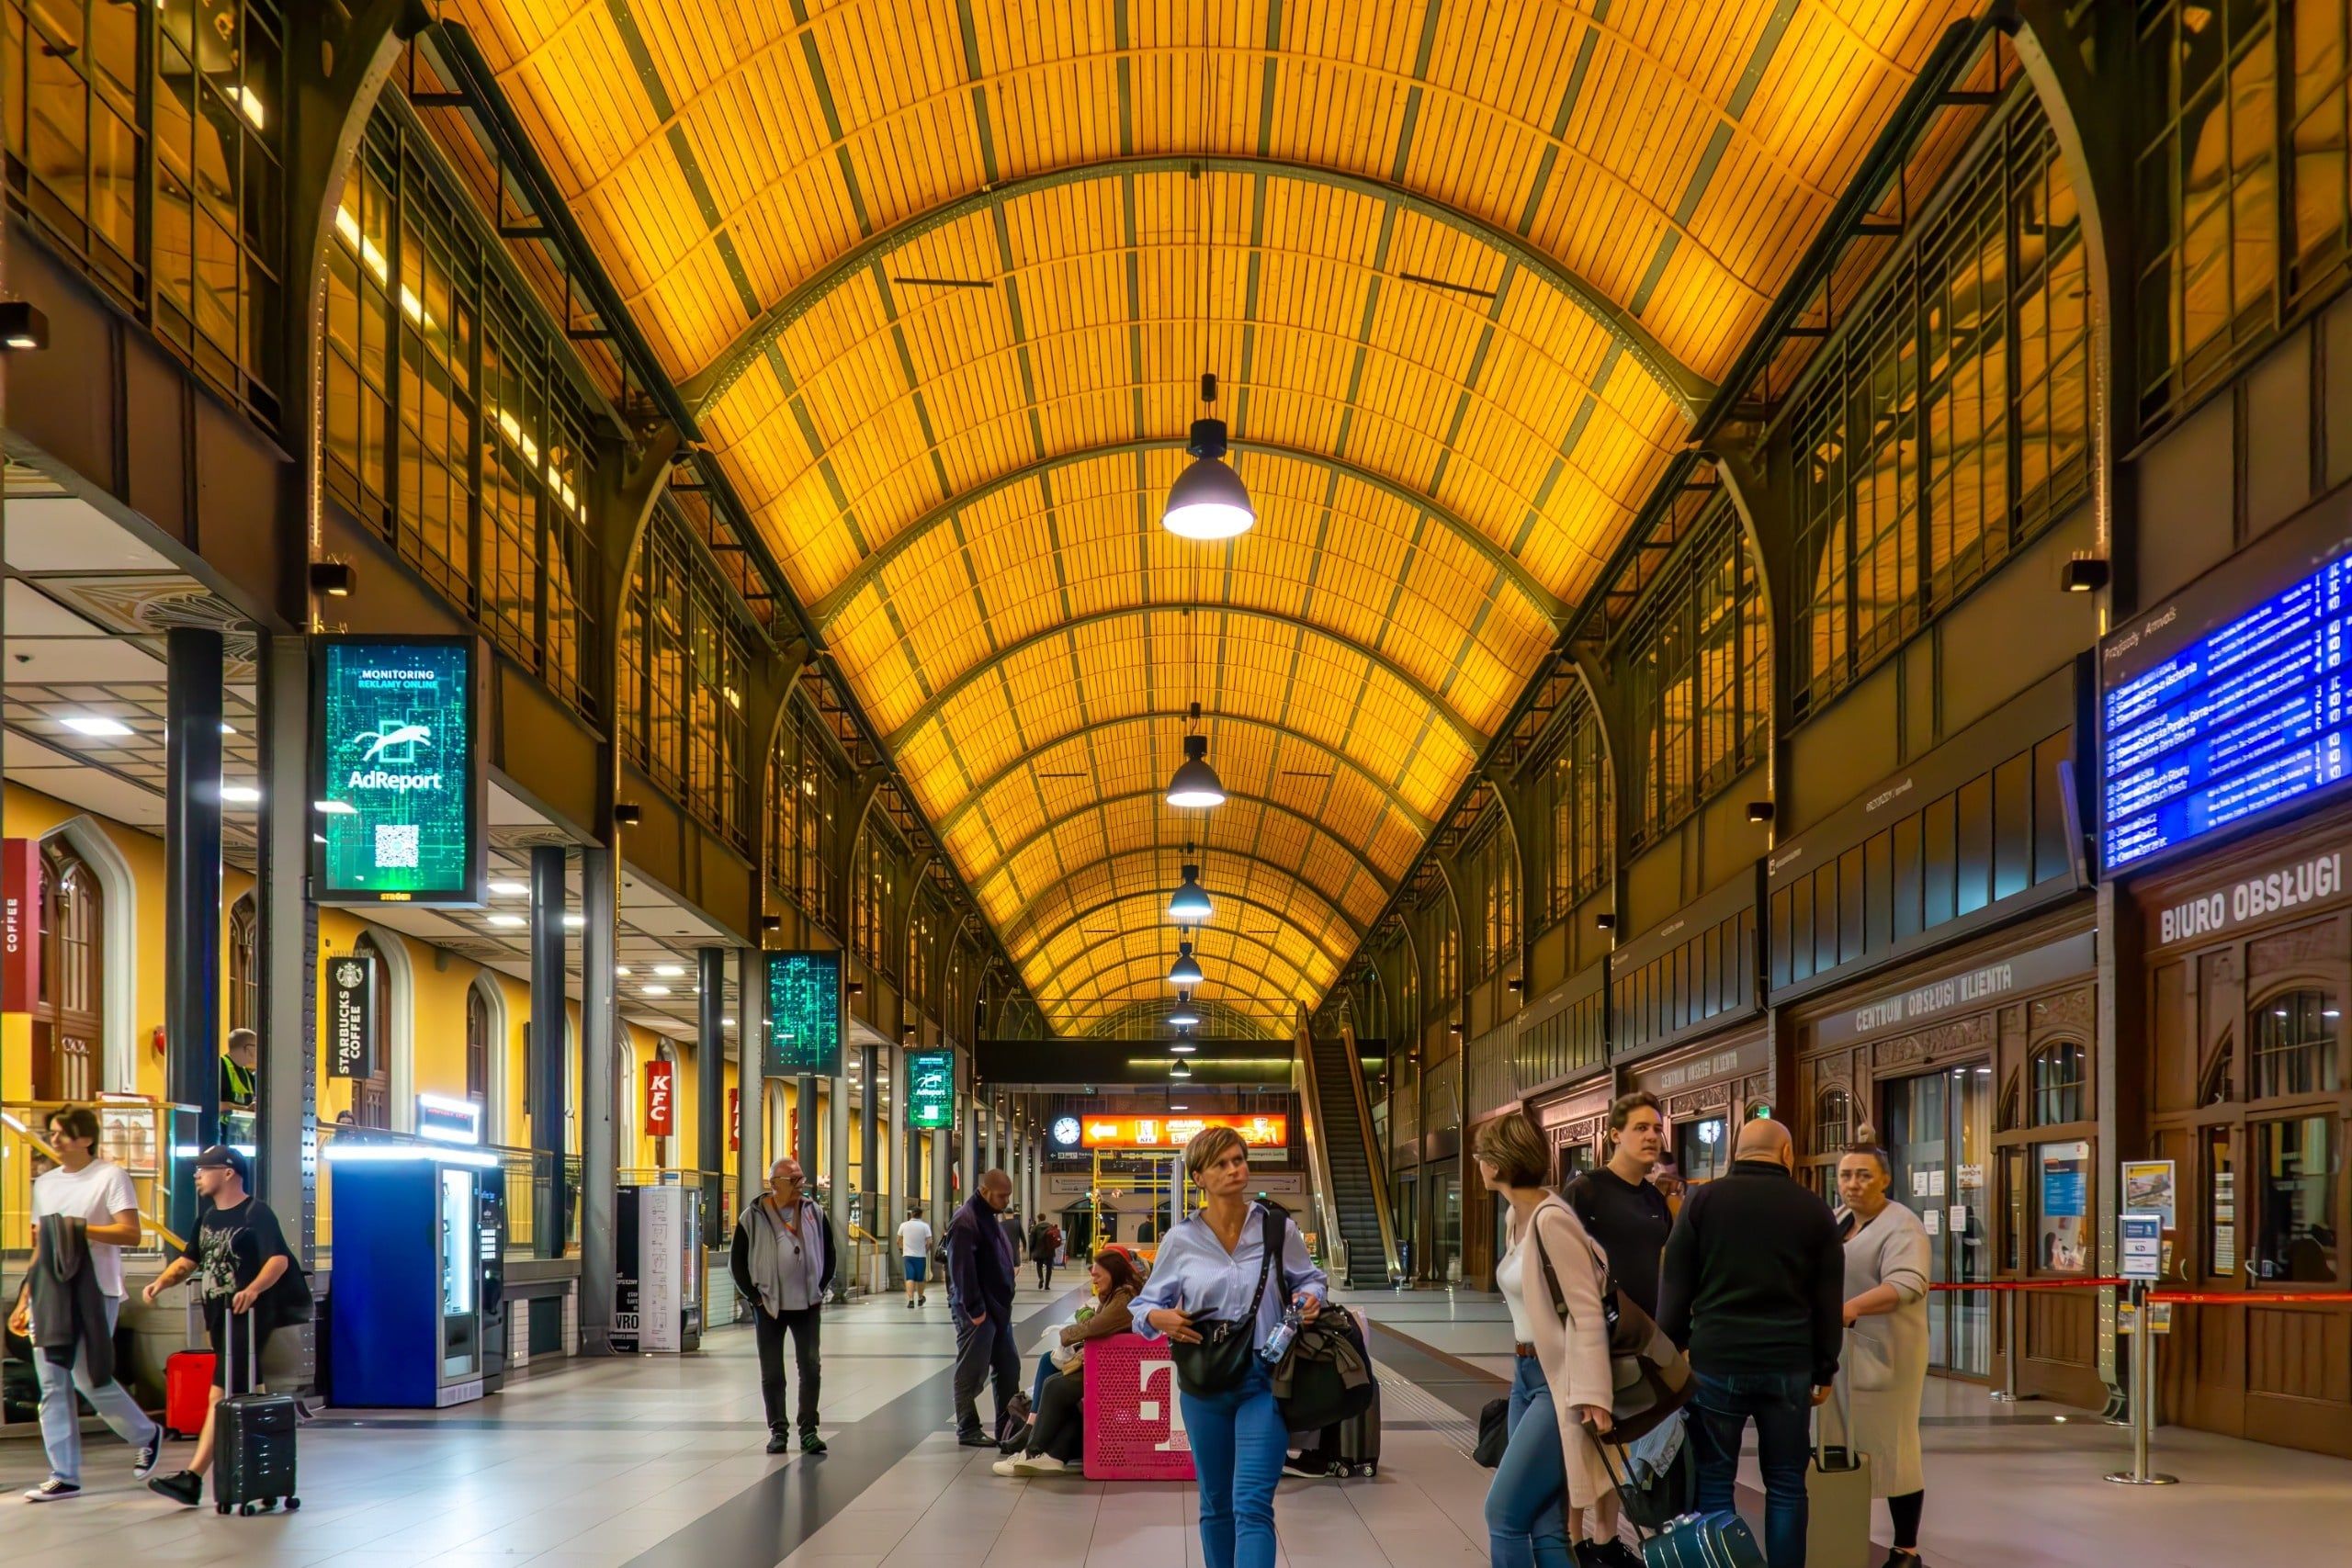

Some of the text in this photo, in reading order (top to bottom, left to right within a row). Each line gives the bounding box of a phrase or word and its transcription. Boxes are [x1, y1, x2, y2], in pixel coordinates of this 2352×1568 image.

[358, 680, 438, 689] REKLAMY ONLINE
[362, 670, 435, 680] MONITORING
[348, 771, 442, 794] AdReport
[2161, 853, 2341, 944] BIURO OBSŁUGI
[7, 898, 18, 953] COFFEE
[1856, 964, 2012, 1032] CENTRUM OBSŁUGI KLIENTA
[339, 991, 350, 1074] STARBUCKS
[350, 1006, 361, 1059] COFFEE
[650, 1075, 671, 1121] KFC
